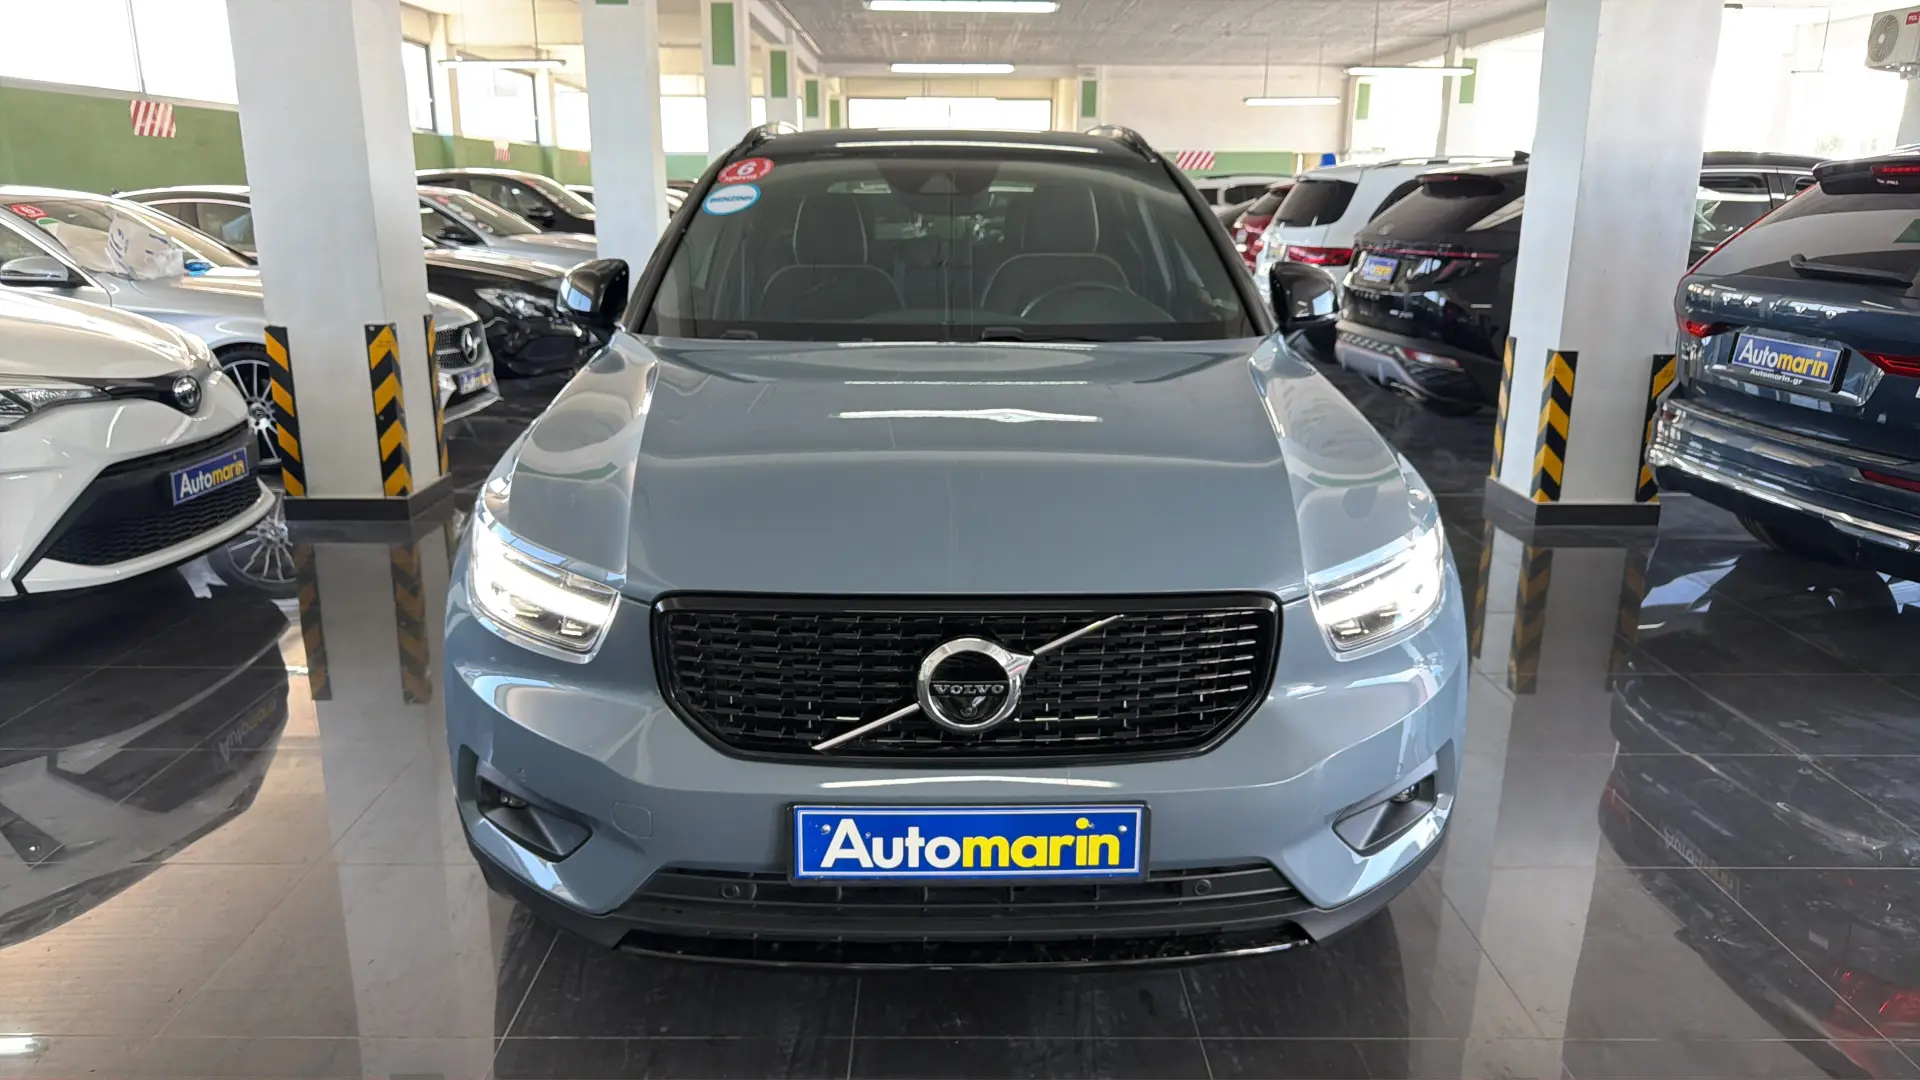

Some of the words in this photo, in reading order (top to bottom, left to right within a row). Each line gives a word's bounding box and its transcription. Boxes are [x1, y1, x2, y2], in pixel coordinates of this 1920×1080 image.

[737, 161, 758, 176] 6
[1738, 339, 1829, 379] Automarin
[1749, 368, 1803, 386] Automarin.gr
[180, 453, 245, 499] Automarin
[933, 684, 1005, 695] VOLVO
[820, 817, 1120, 869] Automarin
